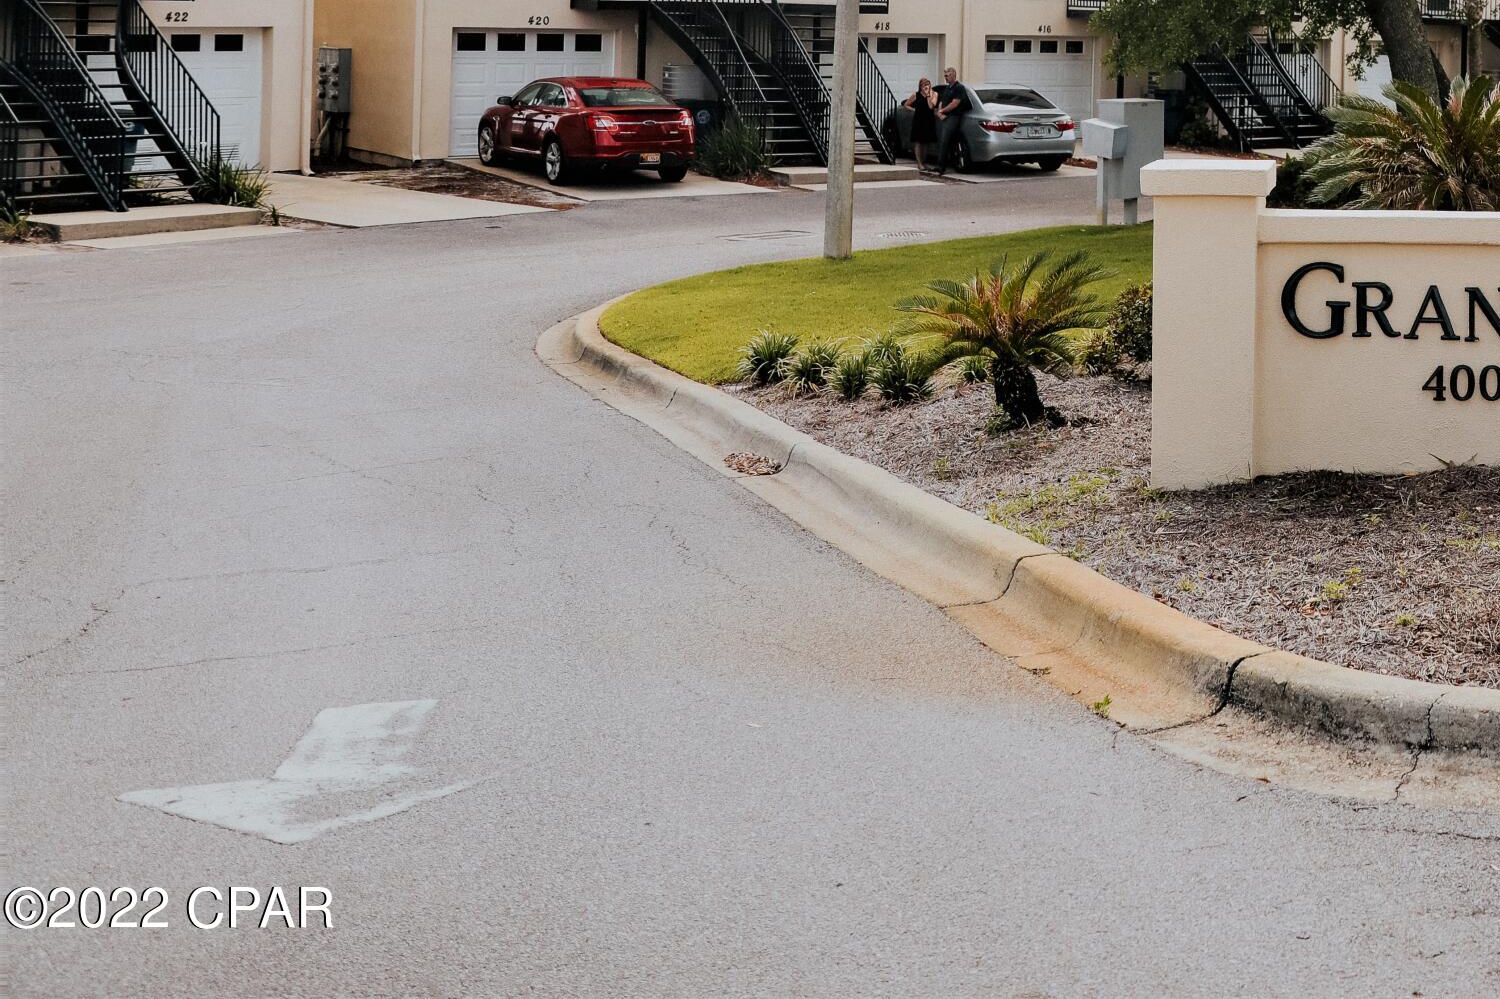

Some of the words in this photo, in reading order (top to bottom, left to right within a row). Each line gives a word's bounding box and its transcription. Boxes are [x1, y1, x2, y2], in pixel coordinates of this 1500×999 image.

[165, 11, 189, 22] 422
[528, 15, 550, 26] 420
[875, 21, 890, 31] 418
